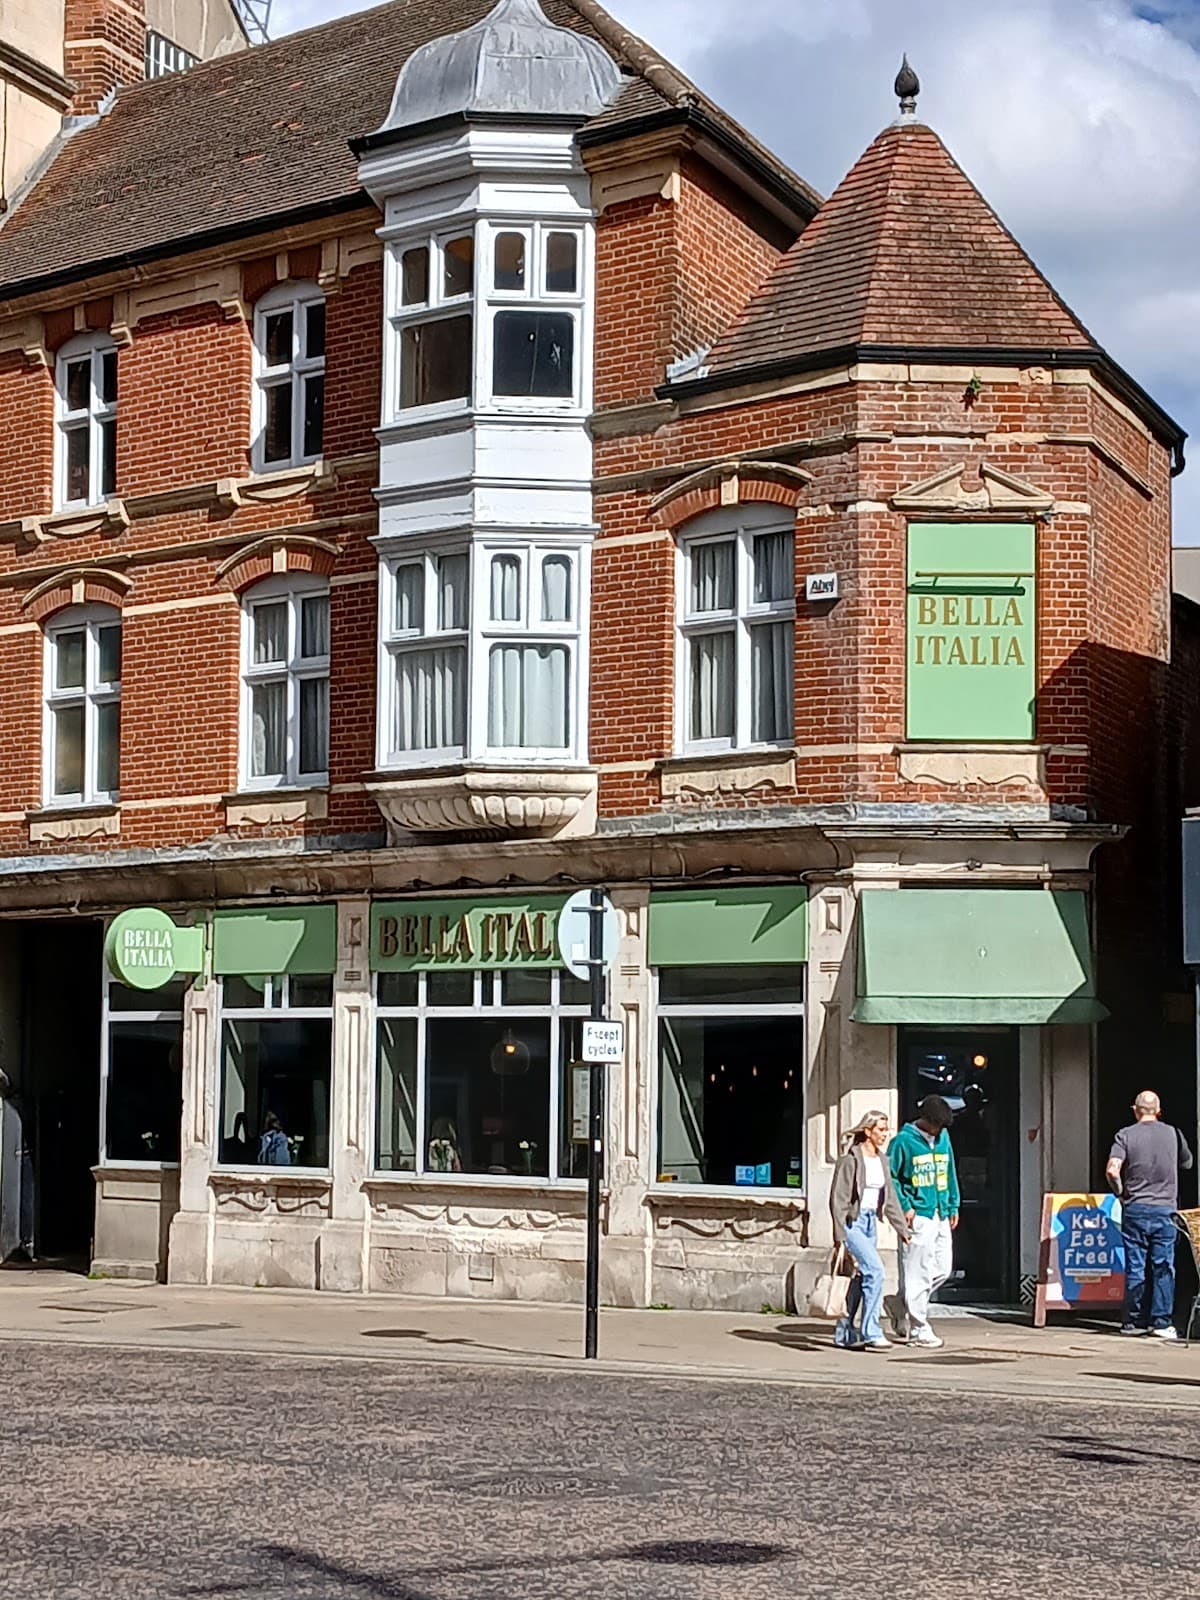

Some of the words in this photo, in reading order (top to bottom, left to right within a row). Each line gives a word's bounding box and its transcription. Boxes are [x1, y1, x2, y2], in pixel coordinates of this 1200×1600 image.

[917, 596, 1023, 626] BELLA
[915, 635, 1024, 666] ITALIA
[124, 929, 172, 948] BELLA
[378, 914, 474, 957] BELLA
[483, 912, 560, 957] ITAL
[124, 948, 173, 967] ITALIA
[588, 1043, 617, 1057] cycles
[1070, 1230, 1108, 1247] Eat
